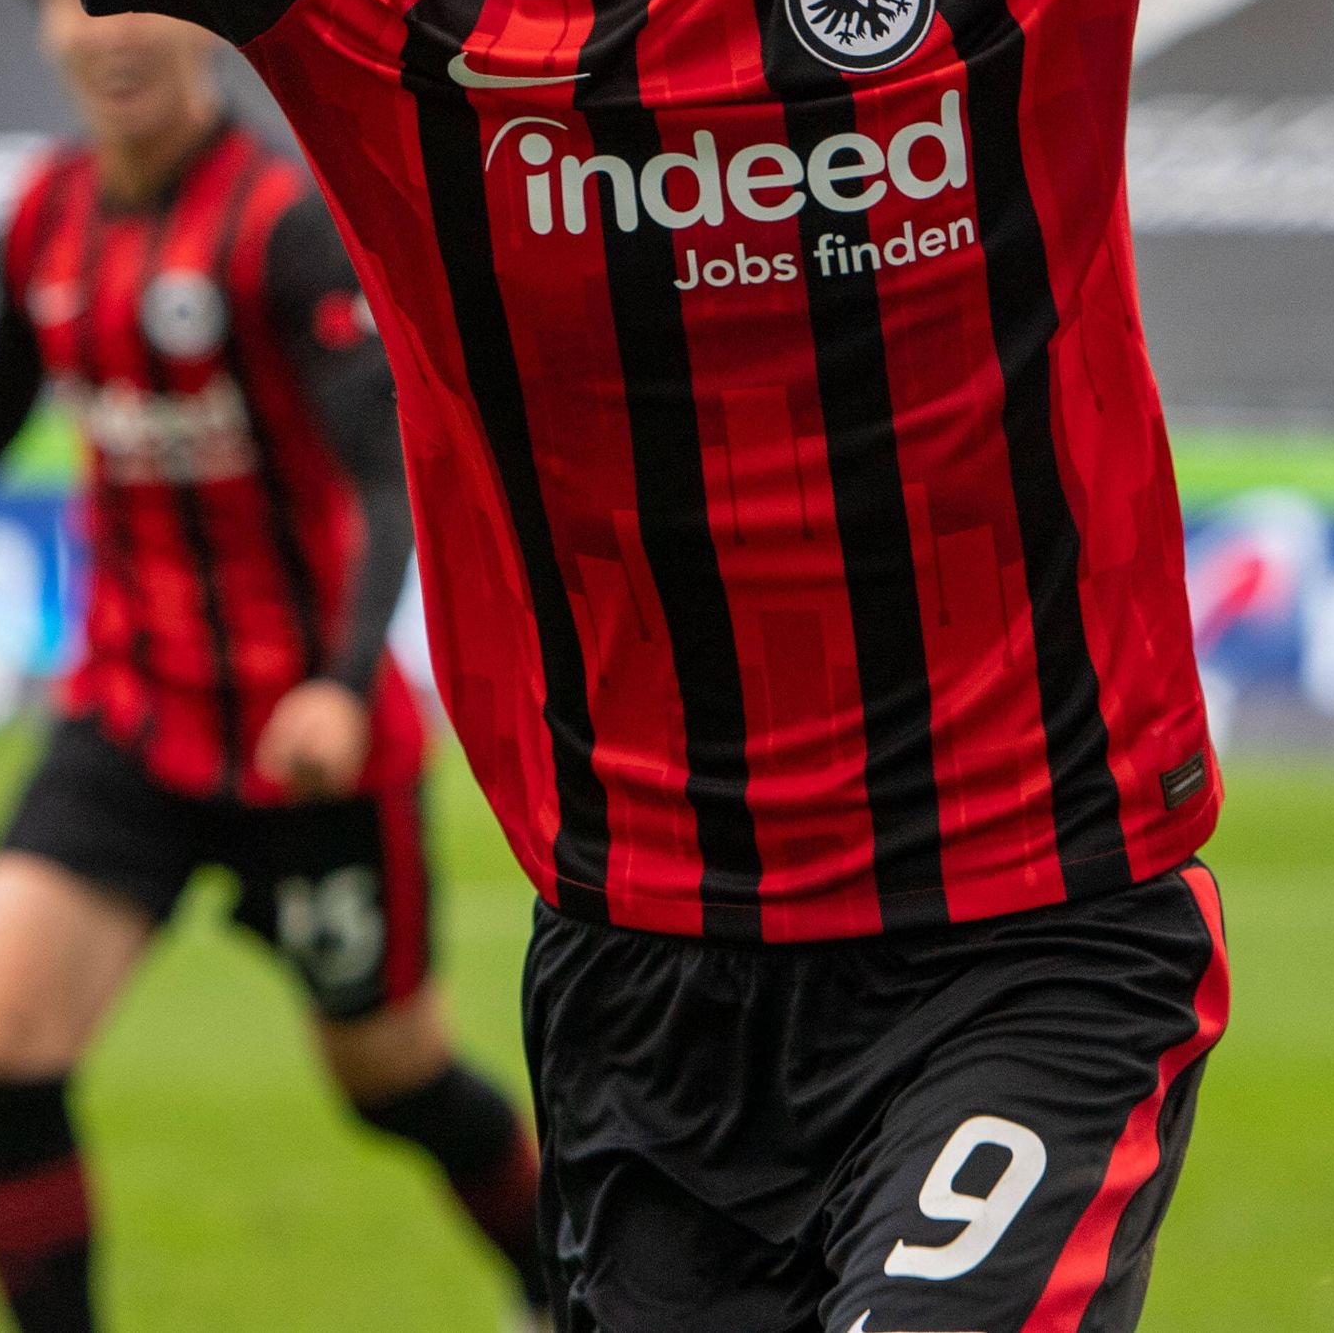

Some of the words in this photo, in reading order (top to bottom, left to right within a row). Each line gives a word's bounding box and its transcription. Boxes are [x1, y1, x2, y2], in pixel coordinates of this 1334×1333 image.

[519, 89, 968, 235] indeed
[673, 243, 797, 291] Jobs
[813, 217, 975, 277] finden
[884, 1116, 1047, 1281] 9
